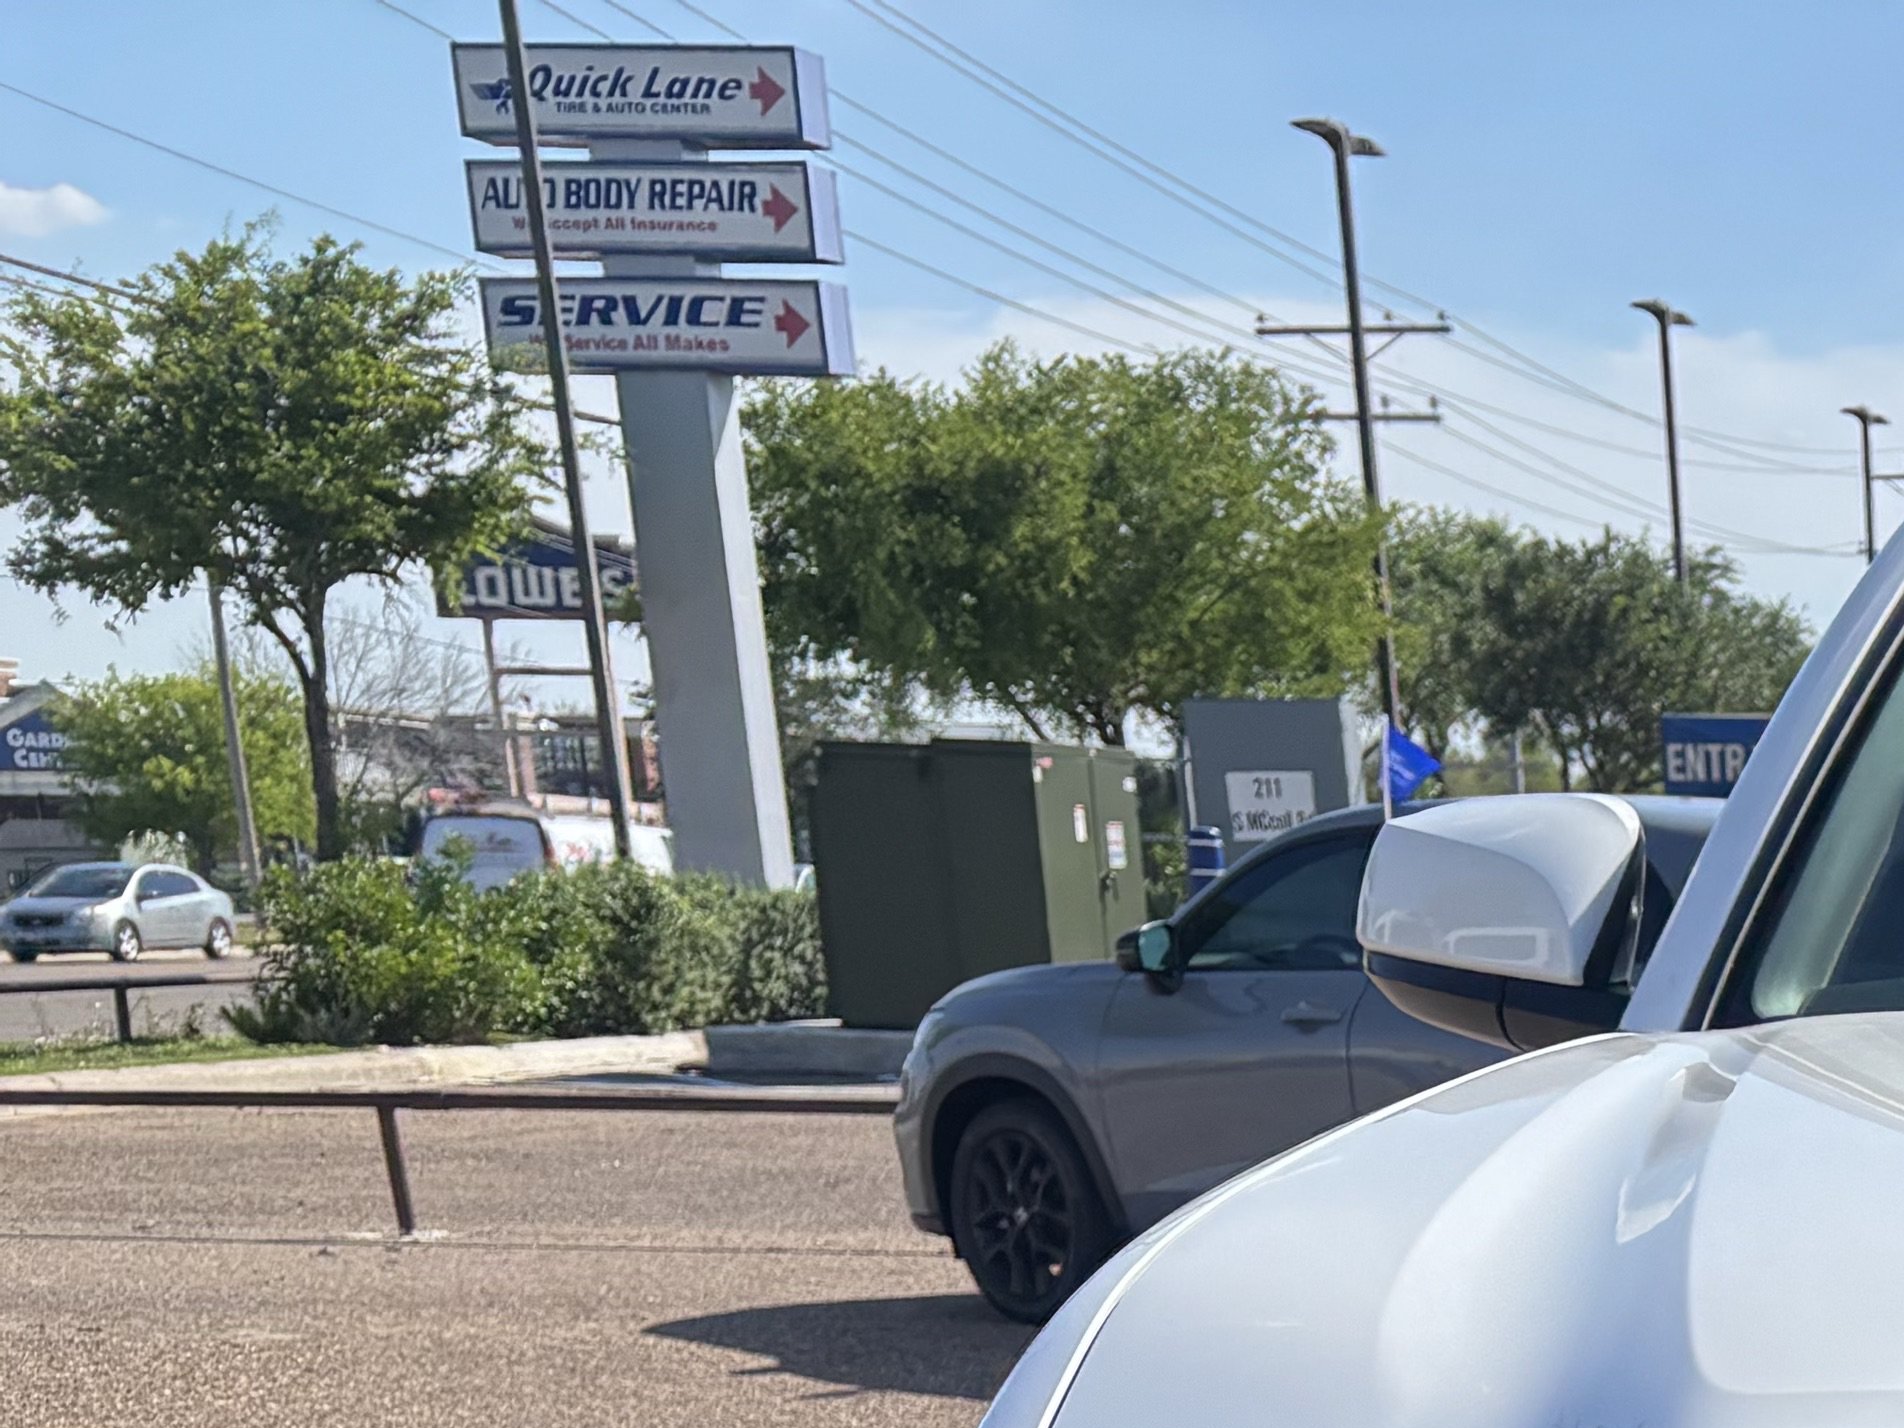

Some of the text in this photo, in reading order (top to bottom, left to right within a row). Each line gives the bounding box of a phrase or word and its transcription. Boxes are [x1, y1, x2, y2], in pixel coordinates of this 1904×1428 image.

[529, 63, 743, 102] Quick Lane
[556, 101, 587, 114] TIRE
[606, 102, 647, 114] AUTO
[650, 102, 711, 115] CENTER
[481, 176, 758, 213] AUO BODY REPAIR
[549, 217, 599, 233] ccept
[604, 217, 626, 231] All
[633, 334, 658, 351] All
[664, 335, 730, 352] Makes
[461, 566, 624, 608] OWES
[6, 728, 65, 749] GARD
[1666, 743, 1746, 782] ENTR
[1252, 777, 1282, 799] 211
